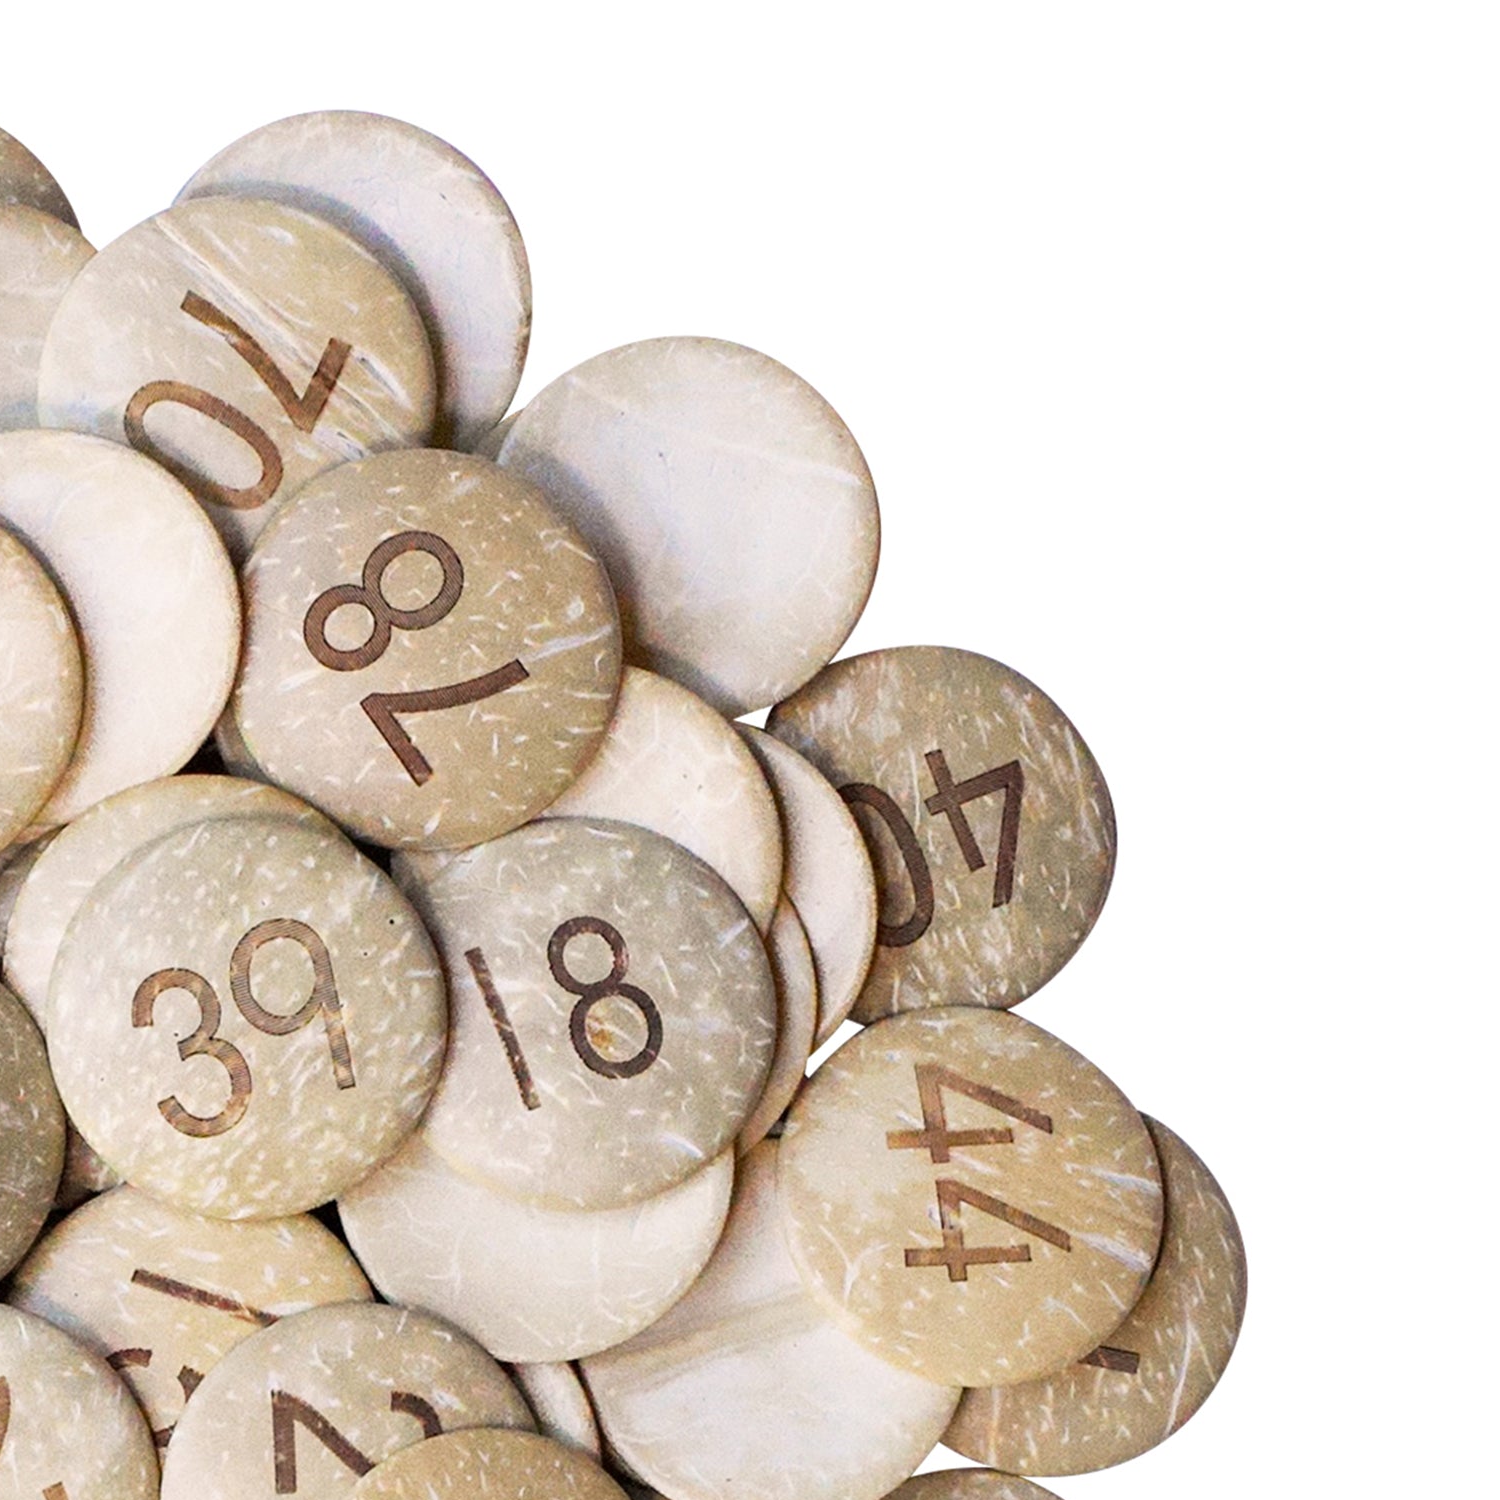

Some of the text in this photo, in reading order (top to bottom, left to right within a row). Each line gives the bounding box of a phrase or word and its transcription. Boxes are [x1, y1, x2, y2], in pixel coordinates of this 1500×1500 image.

[124, 290, 352, 511] 70
[302, 530, 531, 788] 78
[837, 748, 1025, 948] 40
[132, 918, 357, 1138] 39
[463, 915, 664, 1111] 18
[886, 1063, 1072, 1283] 44
